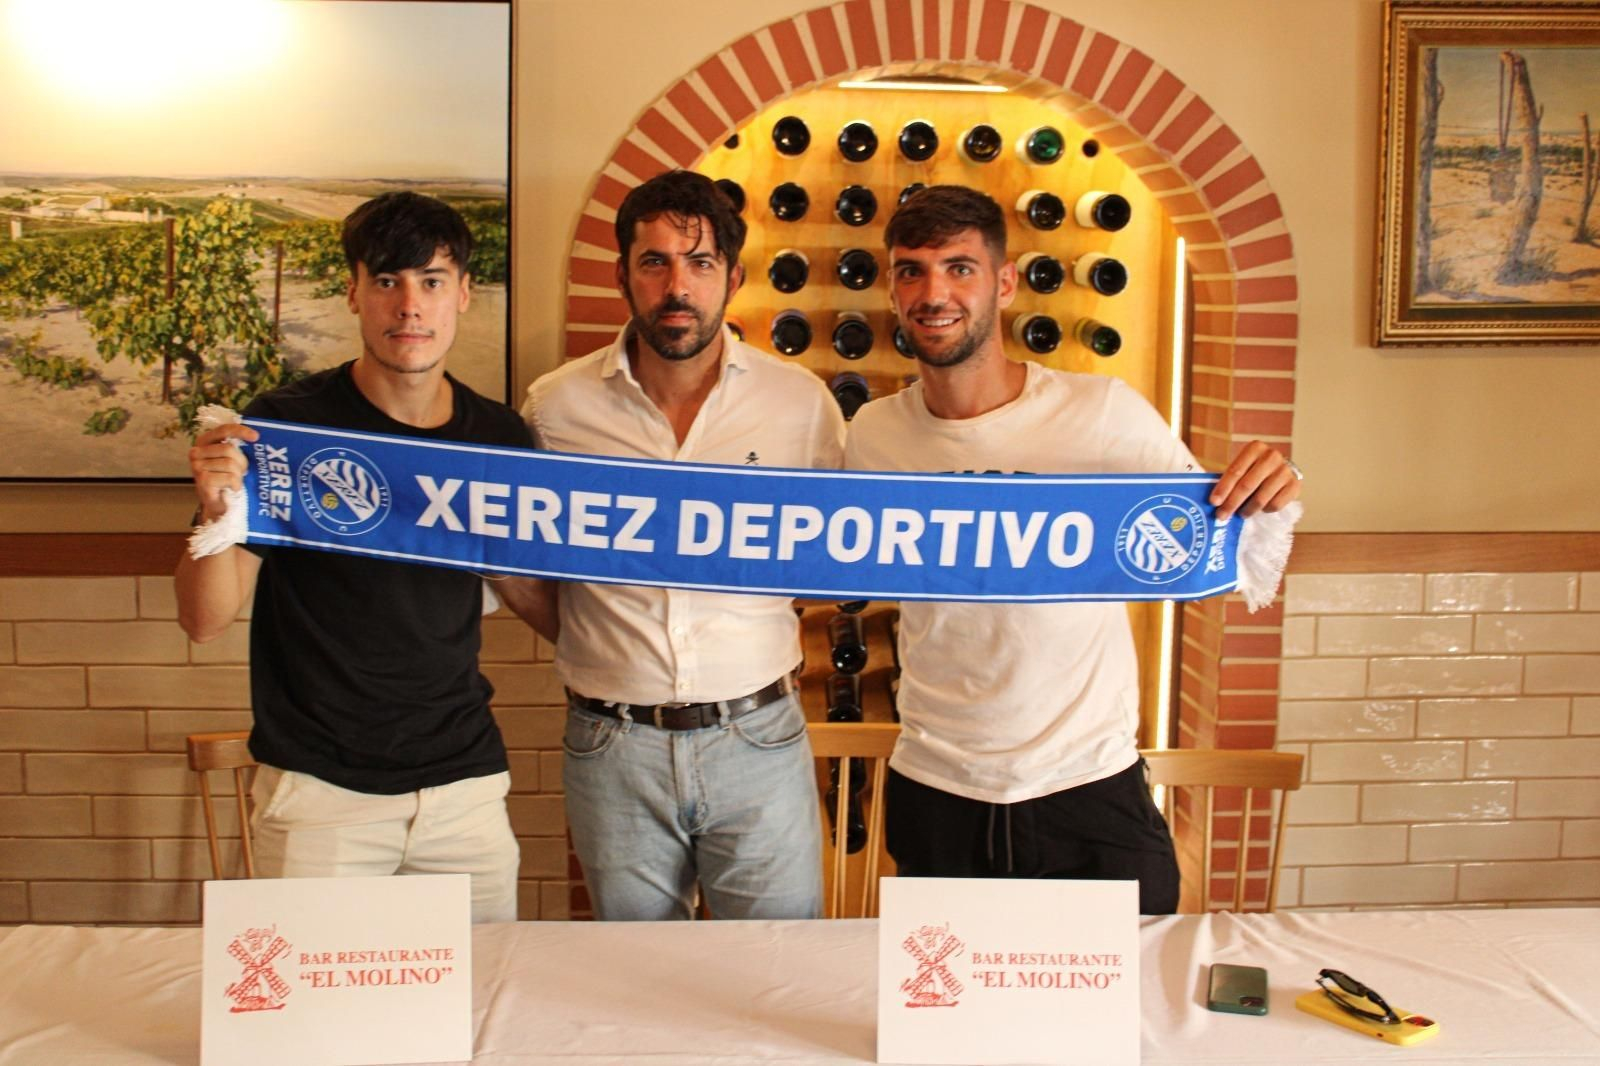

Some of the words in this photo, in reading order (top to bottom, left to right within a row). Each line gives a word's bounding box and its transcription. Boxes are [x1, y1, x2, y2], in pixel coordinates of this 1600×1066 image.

[253, 443, 270, 501] DEPORTIVO
[265, 444, 292, 522] XEREZ
[258, 502, 270, 517] FC
[414, 474, 657, 553] XEREZ
[677, 499, 1095, 569] DEPORTIVO
[299, 952, 333, 966] BAR
[337, 948, 454, 965] RESTAURANTE
[972, 952, 1004, 966] BAR
[1008, 953, 1123, 967] RESTAURANTE
